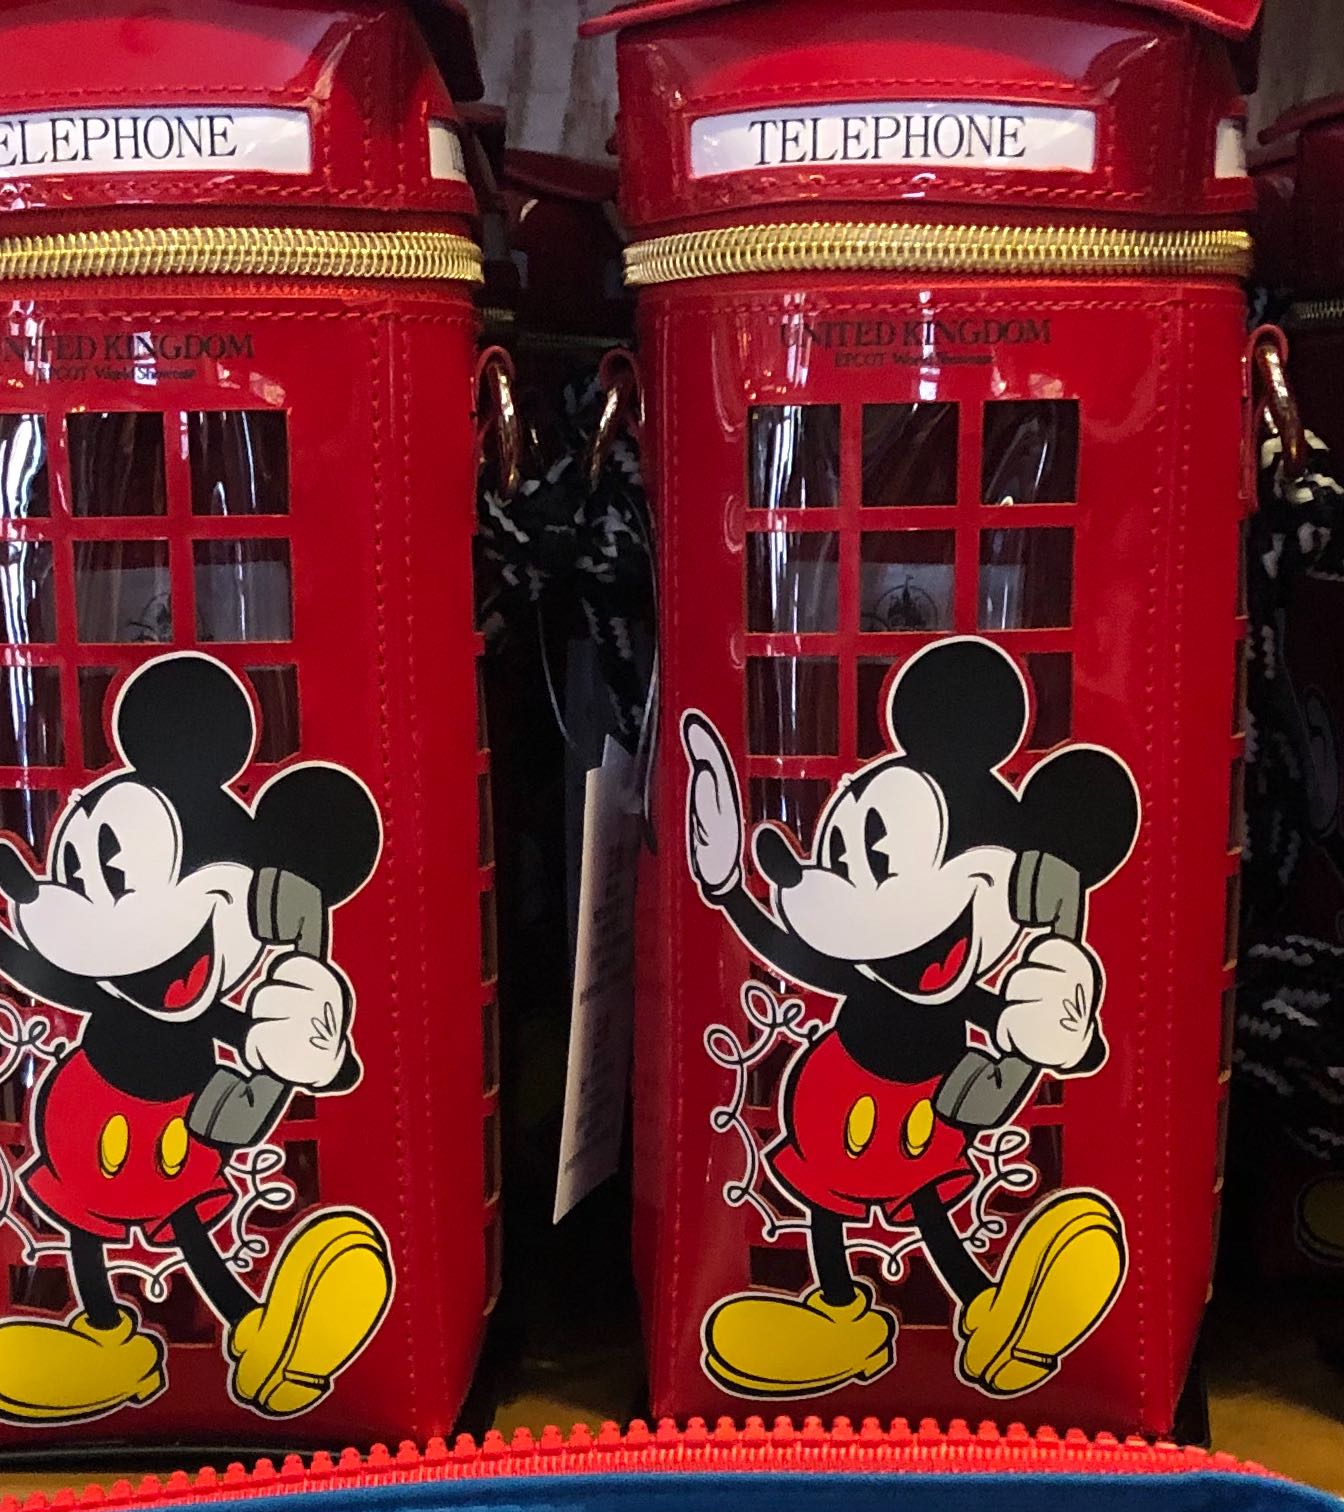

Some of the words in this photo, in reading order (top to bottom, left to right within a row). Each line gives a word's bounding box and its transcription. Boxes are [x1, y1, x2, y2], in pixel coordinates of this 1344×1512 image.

[748, 114, 1027, 166] TELEPHONE
[103, 331, 254, 360] KINGDOM
[779, 320, 896, 348] UNITED
[902, 318, 1053, 345] KINGDOM
